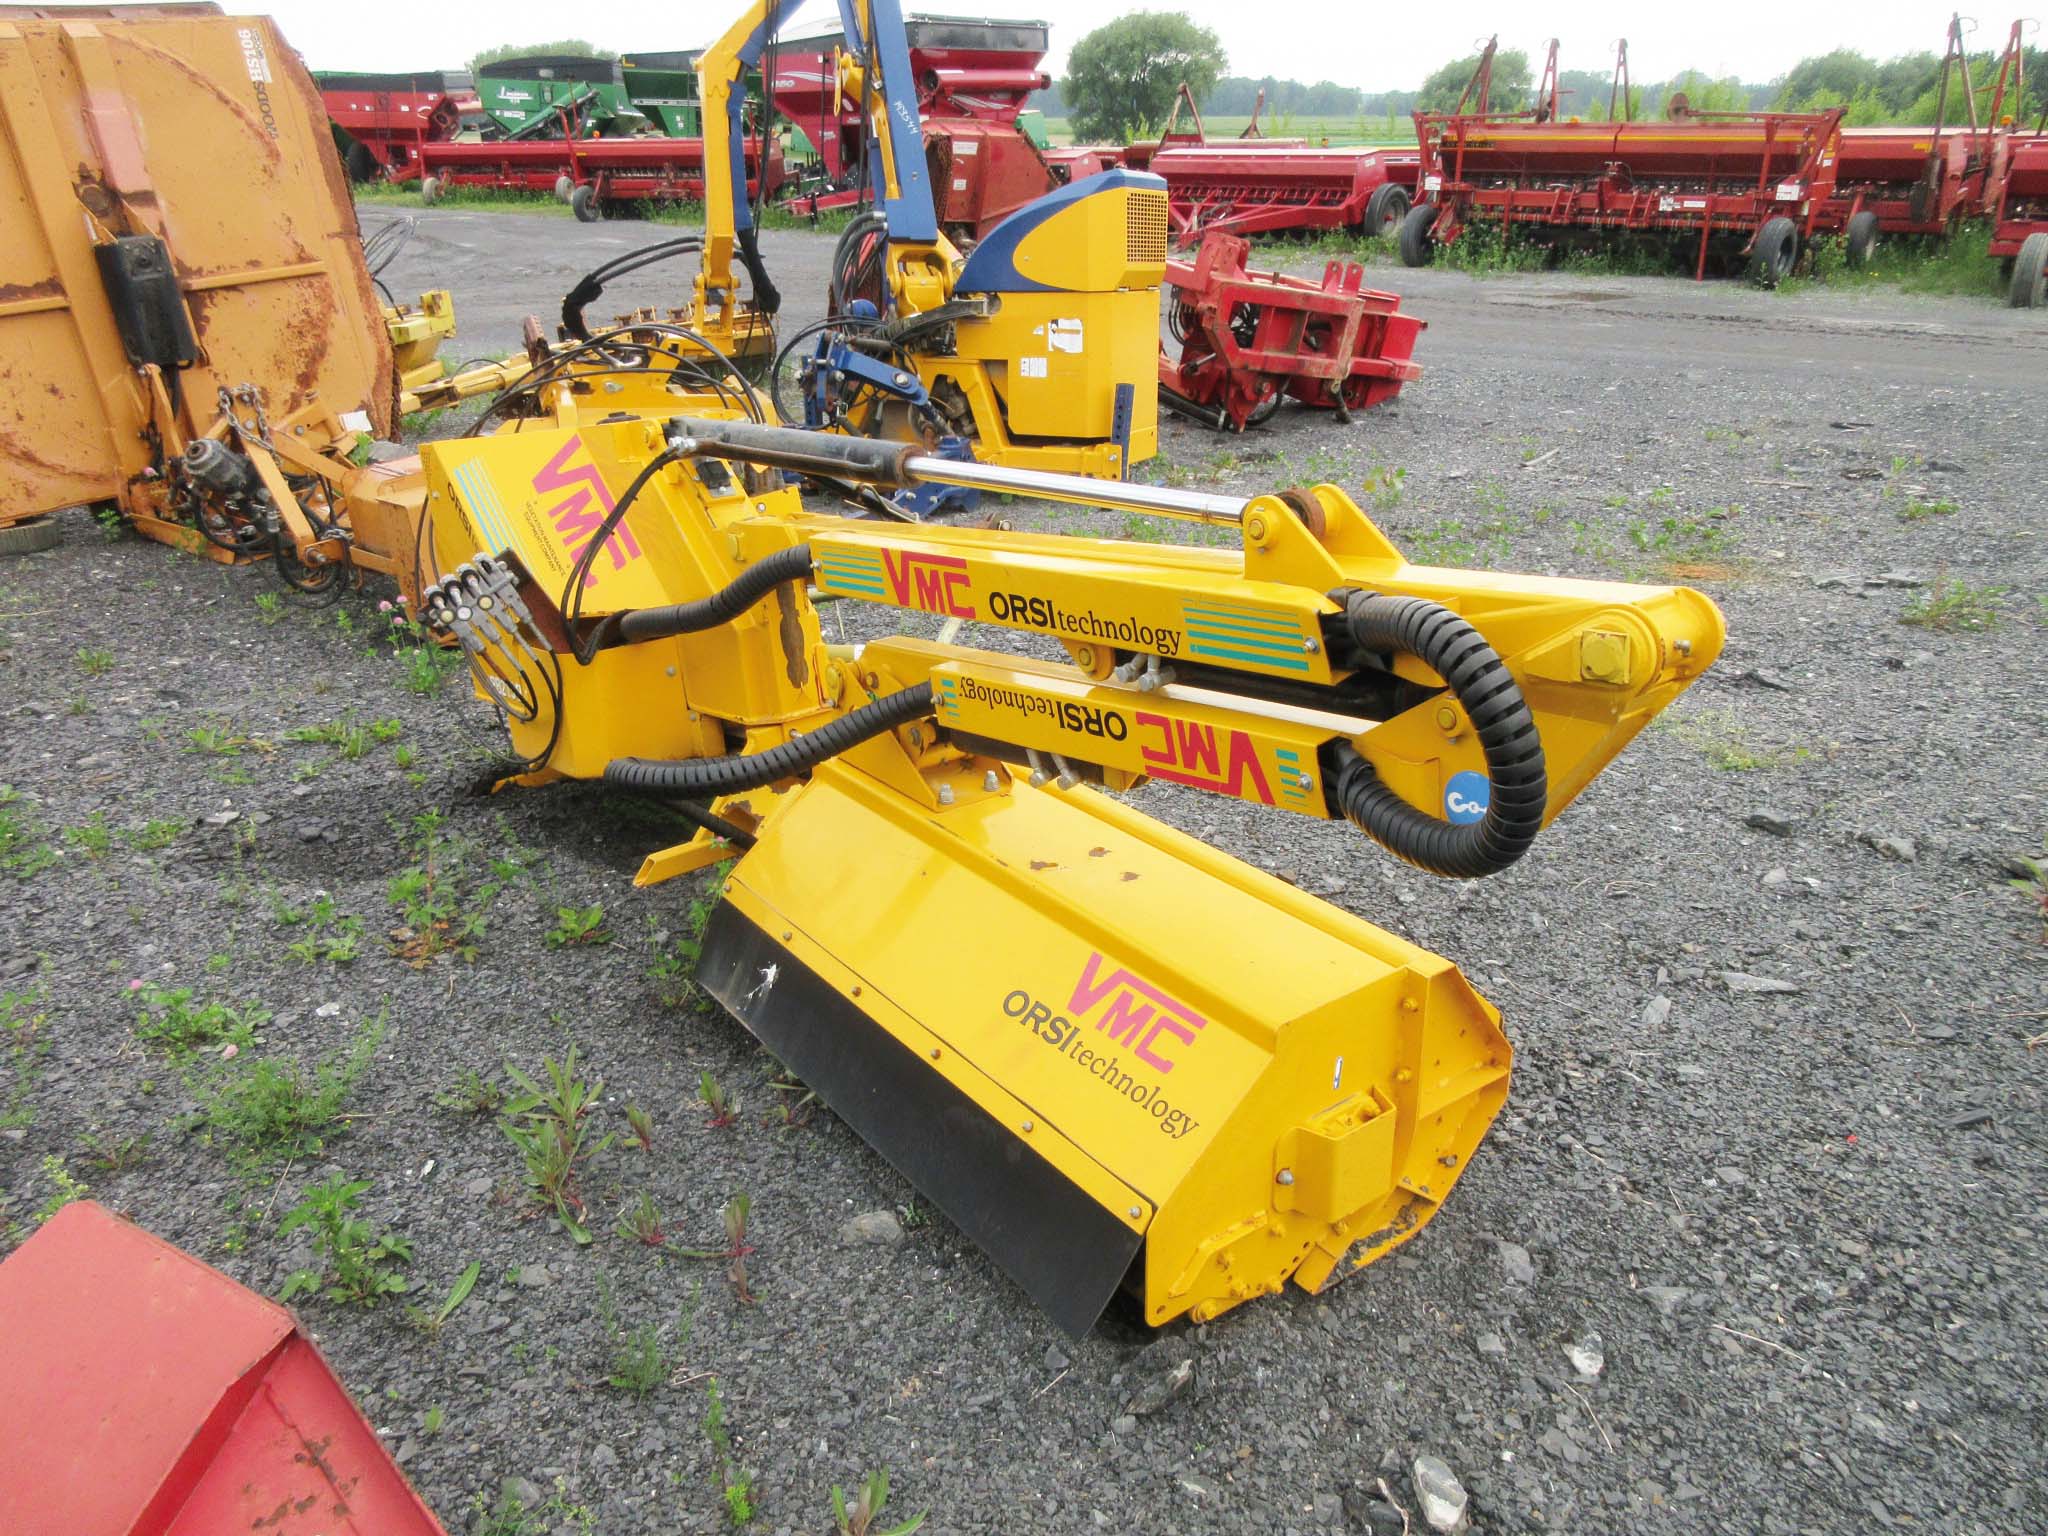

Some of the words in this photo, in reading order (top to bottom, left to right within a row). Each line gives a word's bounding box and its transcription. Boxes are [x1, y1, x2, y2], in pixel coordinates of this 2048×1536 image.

[880, 547, 976, 620] VMC
[1135, 711, 1276, 805] VMC
[1067, 951, 1208, 1074] VMC
